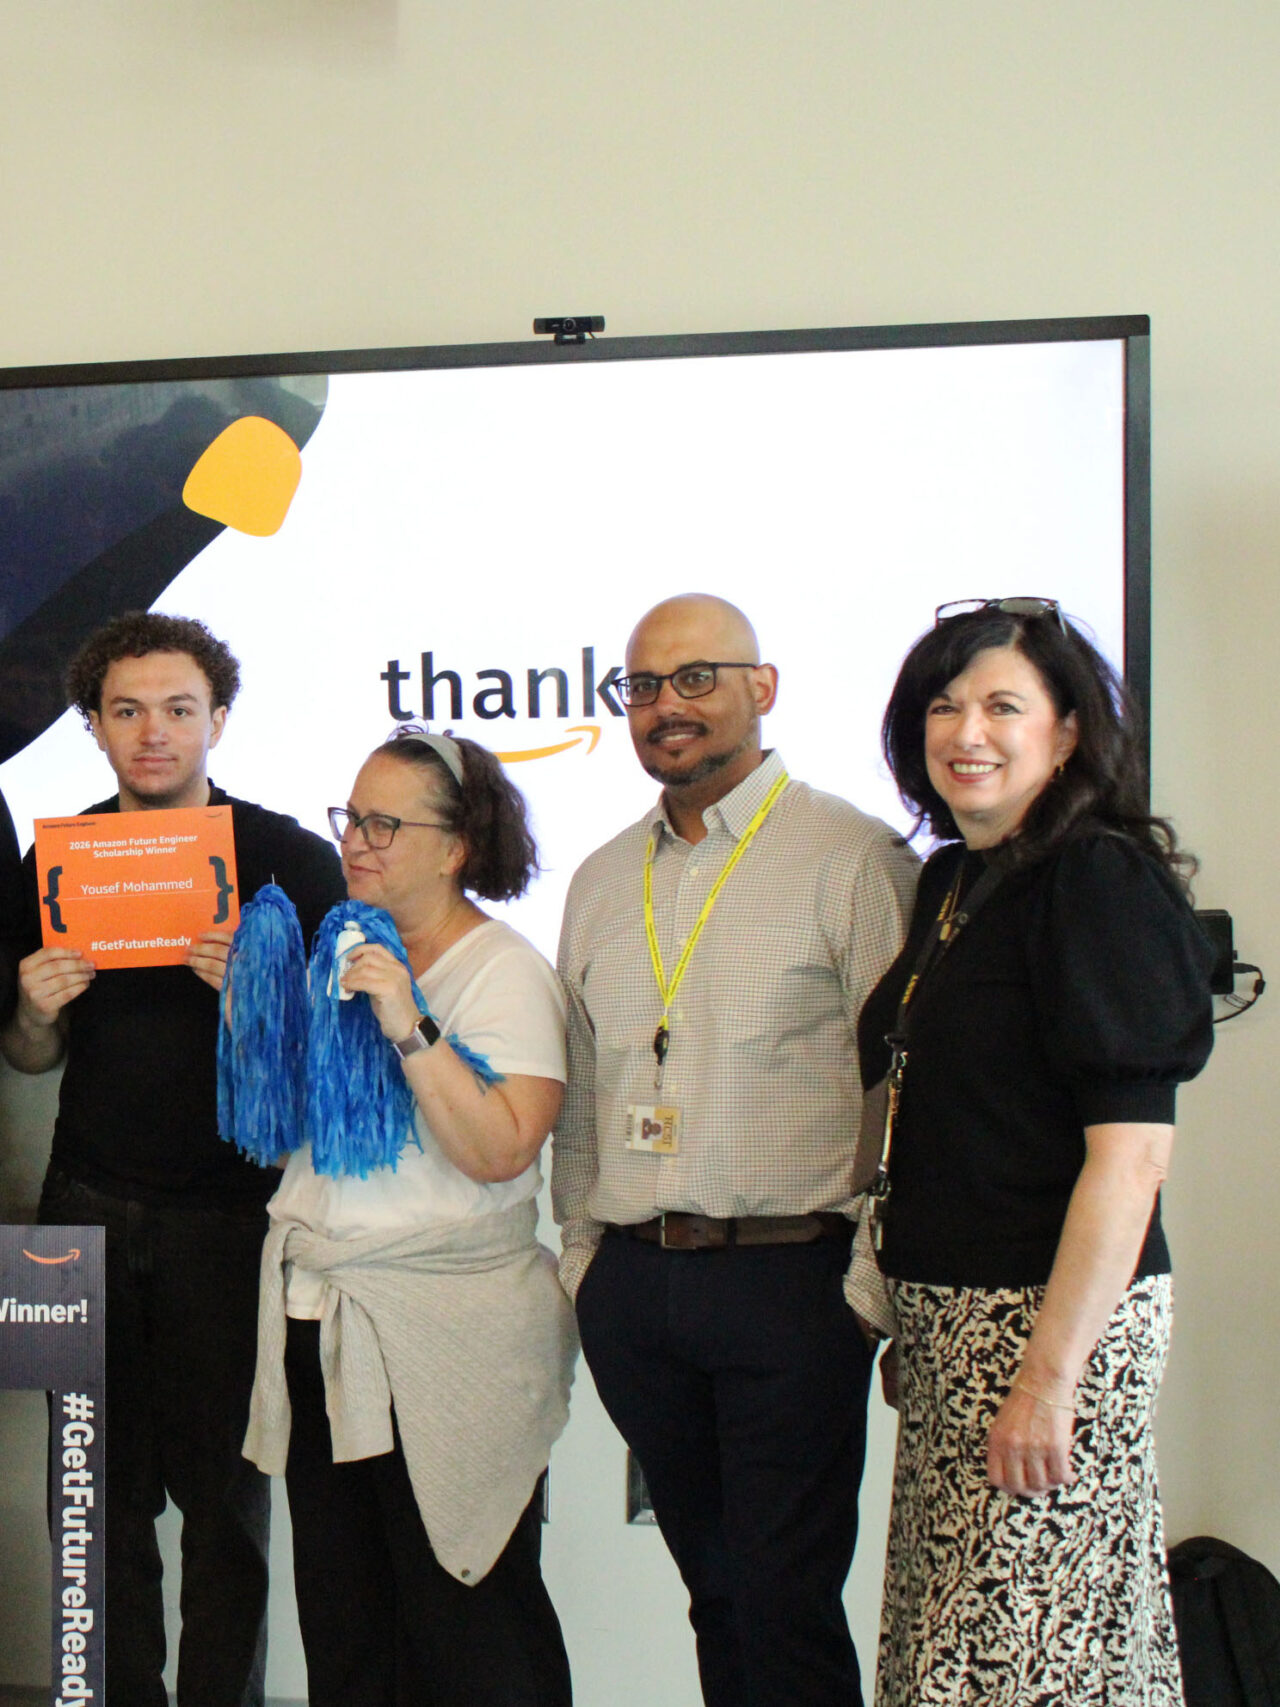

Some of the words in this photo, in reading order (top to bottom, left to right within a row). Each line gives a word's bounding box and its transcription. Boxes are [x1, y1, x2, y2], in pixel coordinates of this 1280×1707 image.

[69, 841, 90, 850] 2026
[92, 839, 127, 849] Amazon
[129, 837, 158, 847] Future
[159, 834, 198, 845] Engineer
[93, 848, 144, 859] Scholarship
[145, 846, 177, 856] Winner
[81, 882, 120, 896] Yousef
[123, 878, 193, 893] Mohammed
